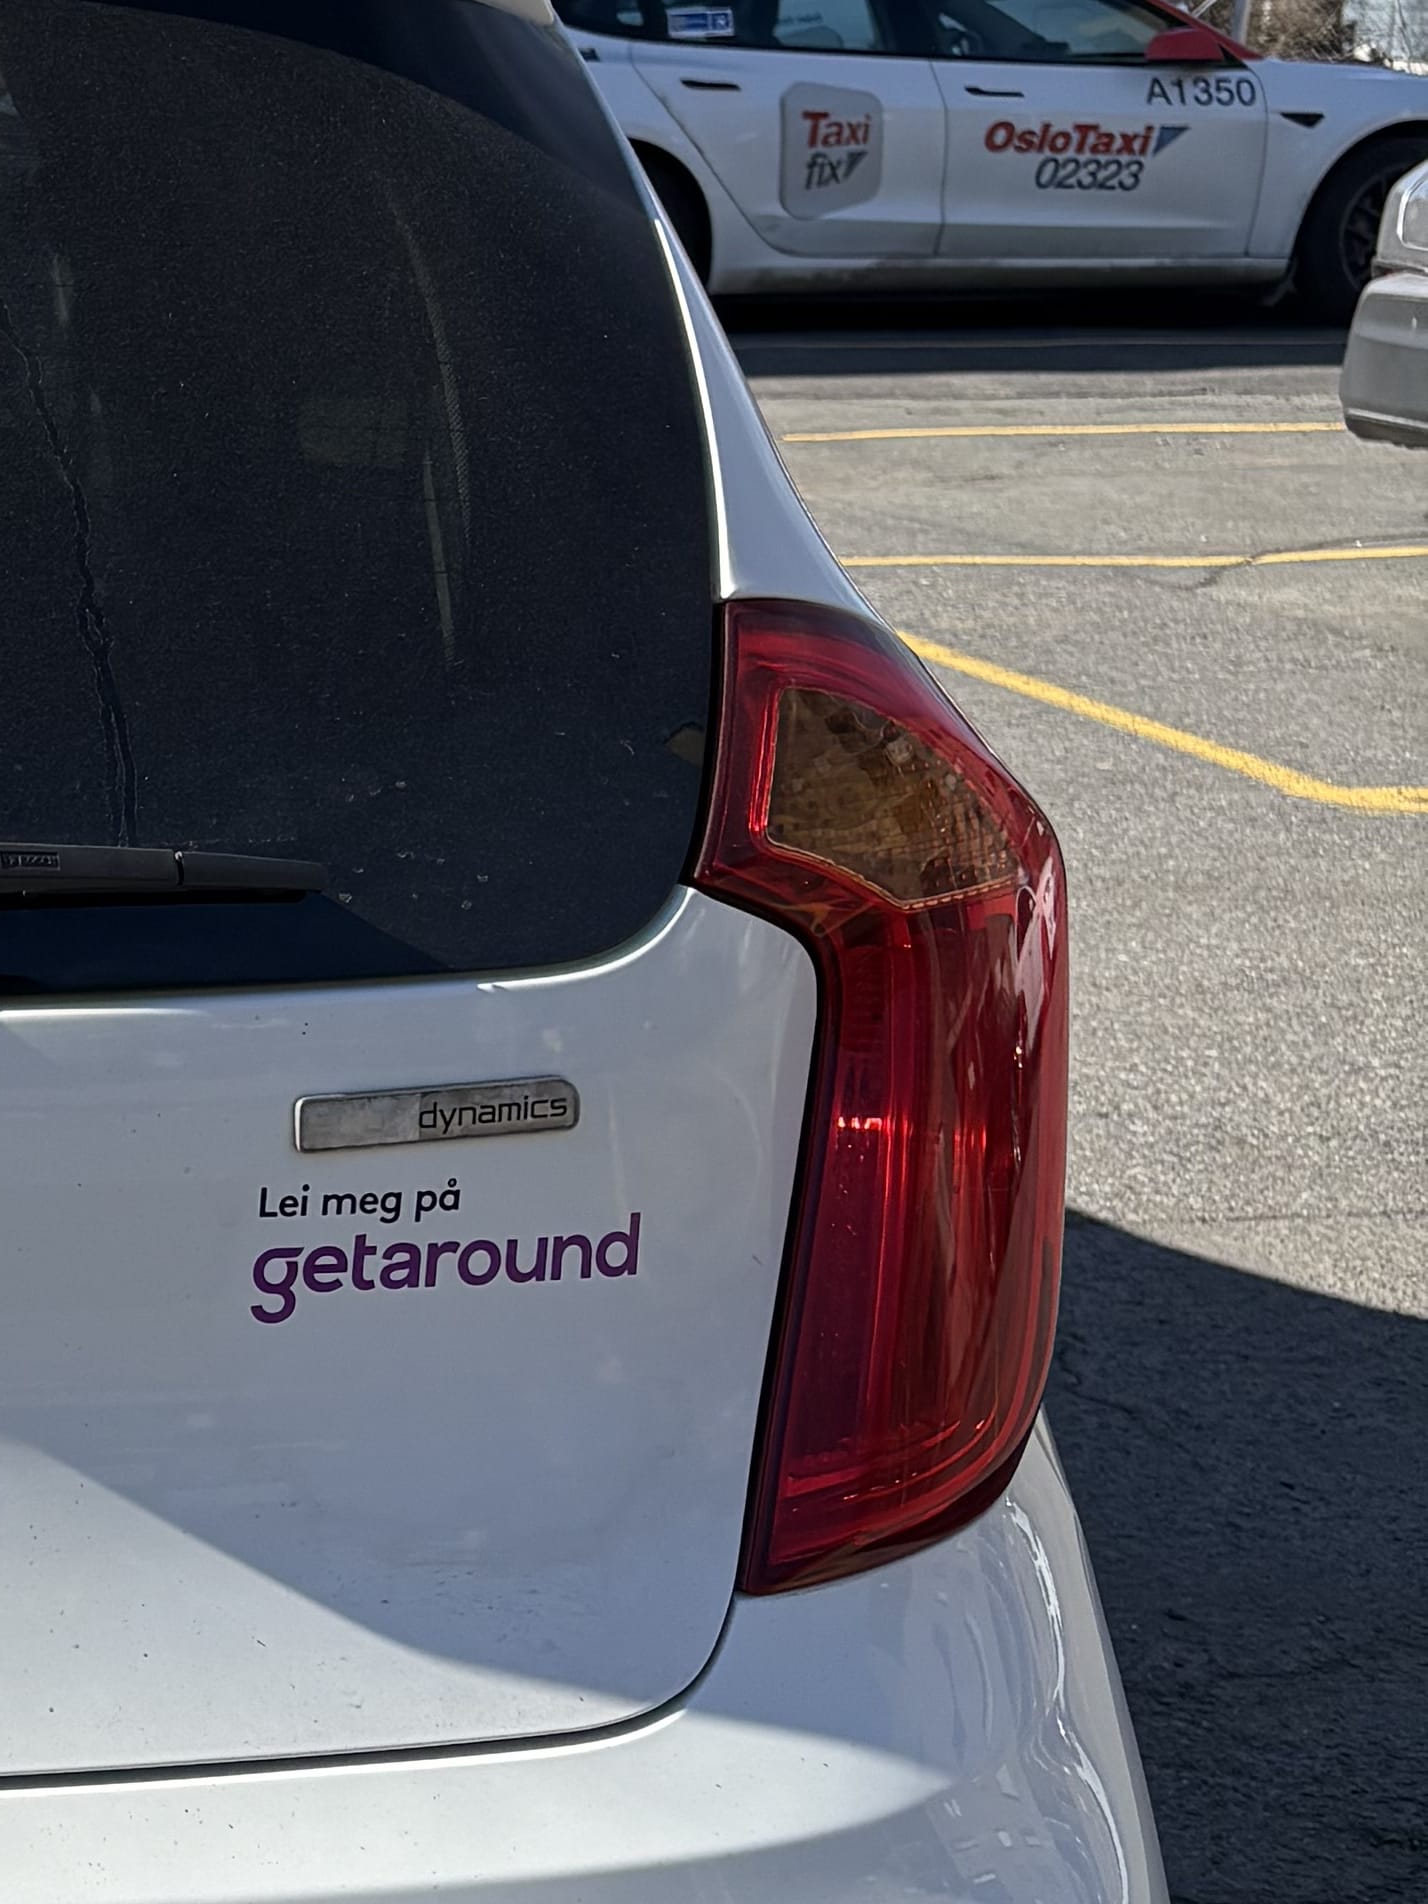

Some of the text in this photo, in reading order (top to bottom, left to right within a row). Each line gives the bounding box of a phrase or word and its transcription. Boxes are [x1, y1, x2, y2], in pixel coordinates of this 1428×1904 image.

[1147, 77, 1257, 107] A1350
[801, 111, 872, 149] Taxi
[985, 121, 1154, 156] OsloTaxi
[805, 151, 841, 190] fix
[1035, 158, 1145, 190] 02323
[419, 1096, 568, 1134] dynamics
[259, 1178, 461, 1224] Lei meg på
[250, 1212, 641, 1324] getaround
